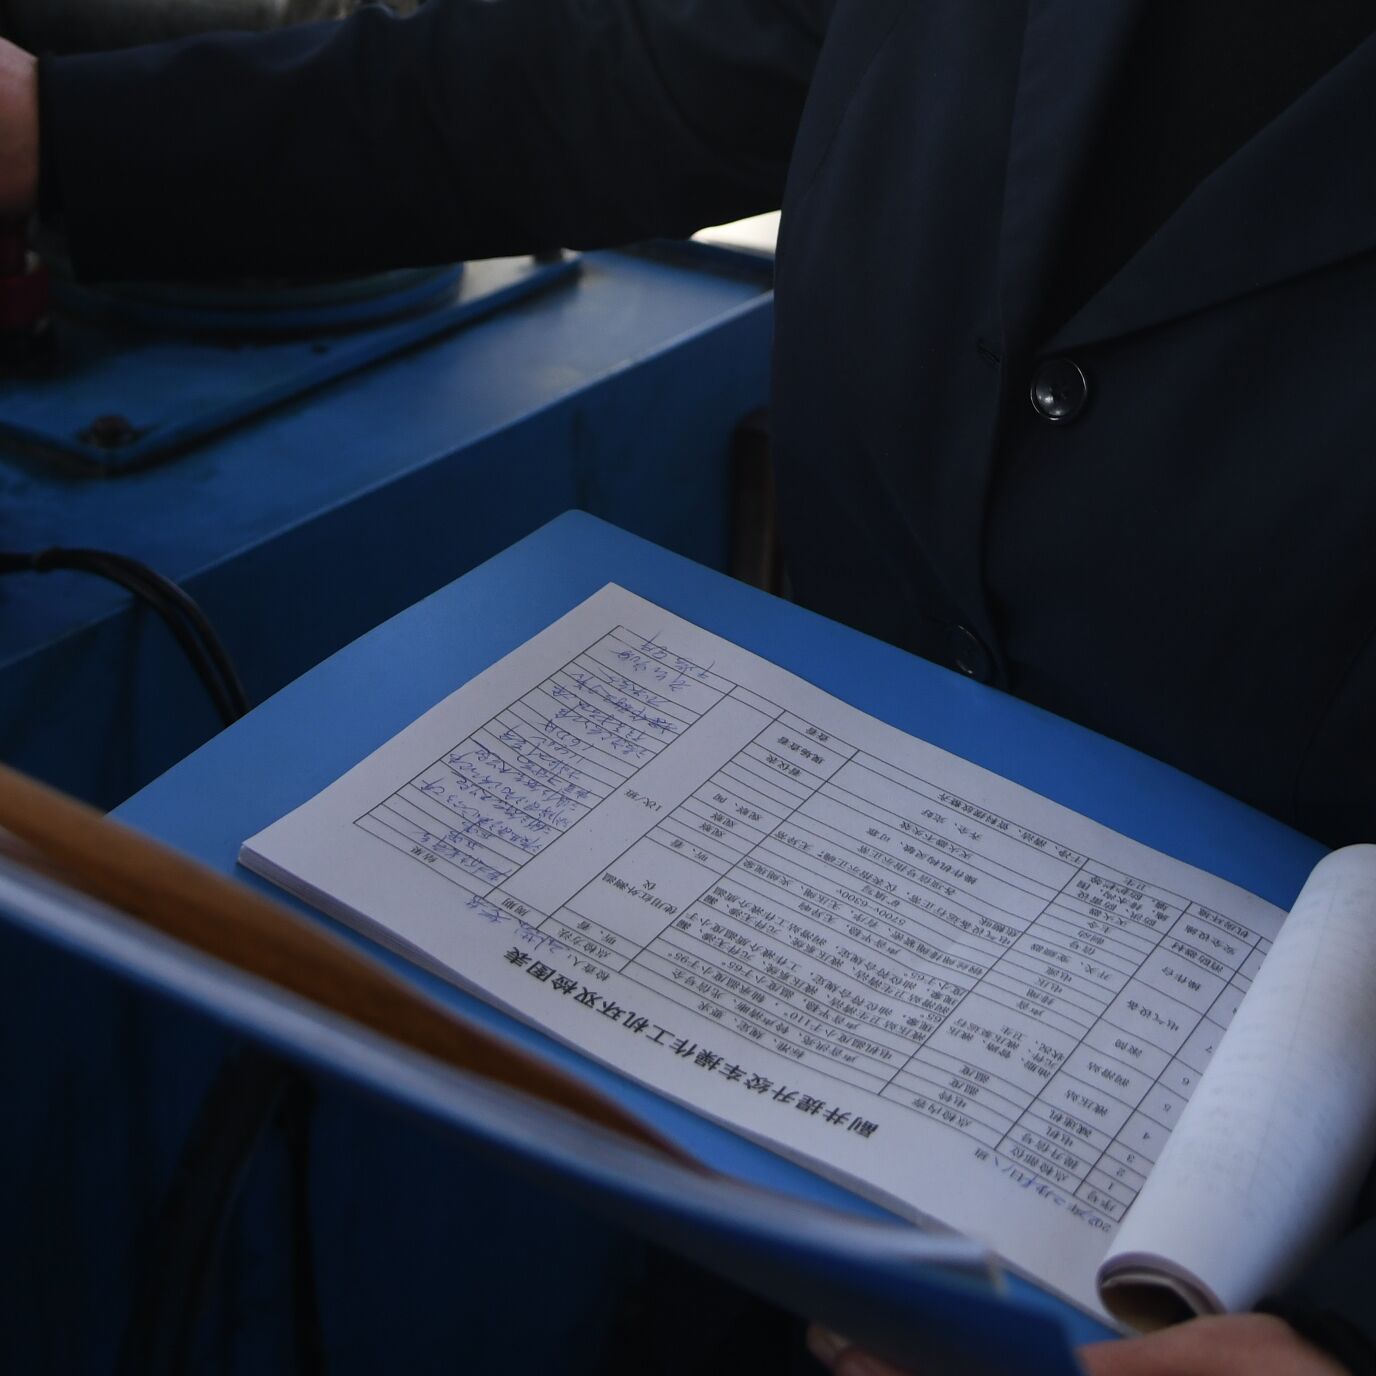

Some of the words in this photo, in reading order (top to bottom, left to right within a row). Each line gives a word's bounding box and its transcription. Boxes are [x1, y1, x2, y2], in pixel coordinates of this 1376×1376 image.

[801, 725, 831, 743] 查看
[772, 734, 827, 765] 现场查看
[761, 753, 805, 778] 看仪表
[696, 819, 728, 840] 观察
[707, 809, 739, 829] 观察
[407, 844, 440, 864] 结果
[598, 870, 680, 916] 使用红外测温
[638, 877, 658, 892] 仪
[498, 896, 531, 917] 周期
[553, 926, 613, 961] 点检方法
[500, 945, 878, 1140] 副井提升绞车操作工机环双检图表
